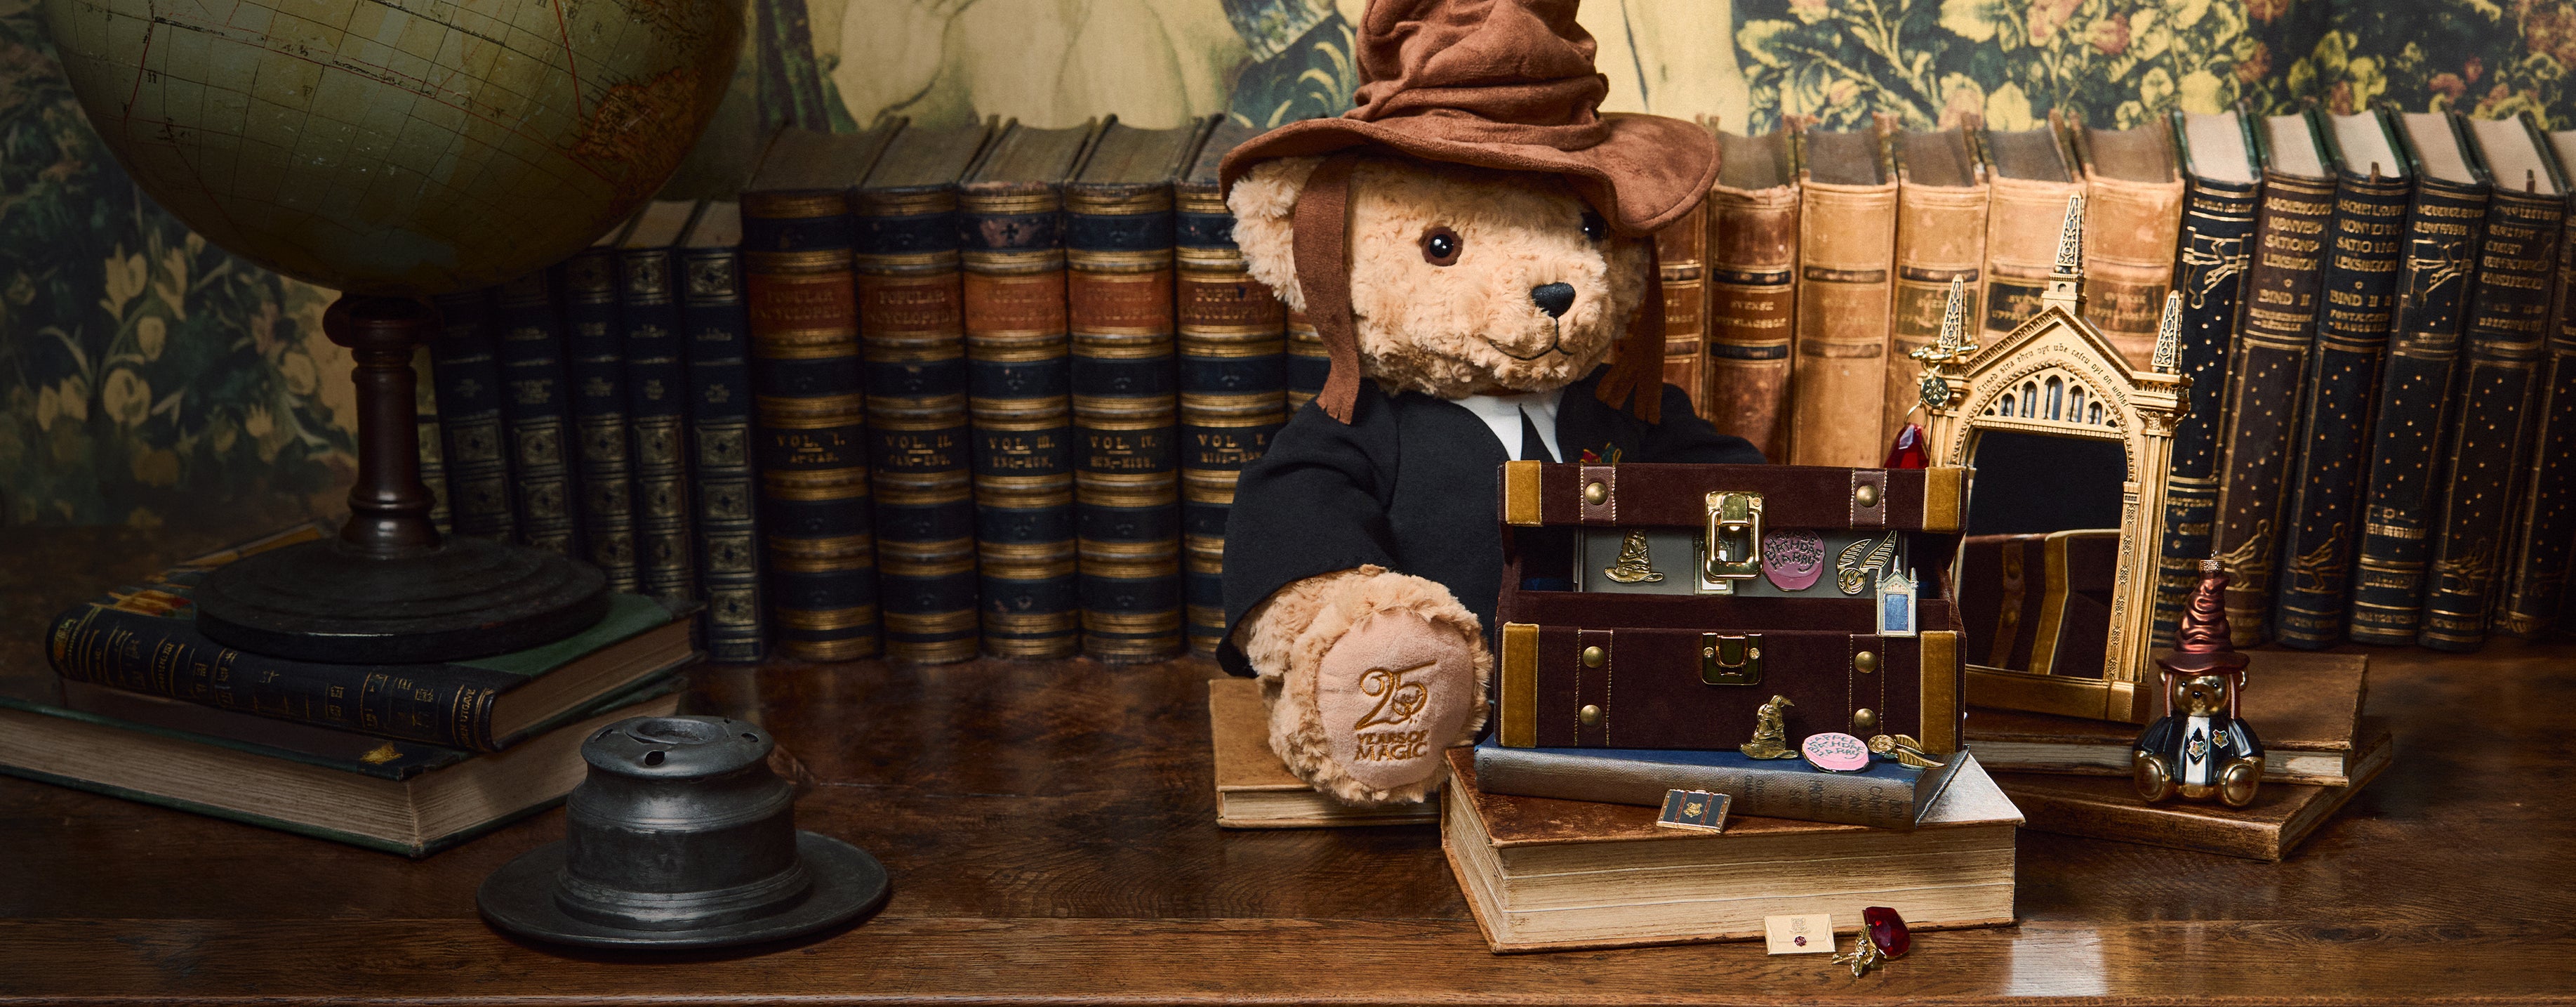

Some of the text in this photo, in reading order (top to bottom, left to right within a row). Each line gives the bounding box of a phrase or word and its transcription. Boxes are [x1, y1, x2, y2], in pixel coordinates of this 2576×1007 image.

[2258, 289, 2294, 305] BIND
[2329, 289, 2363, 307] BIND
[1770, 552, 1816, 572] HARRY
[1354, 742, 1428, 761] MAGIC
